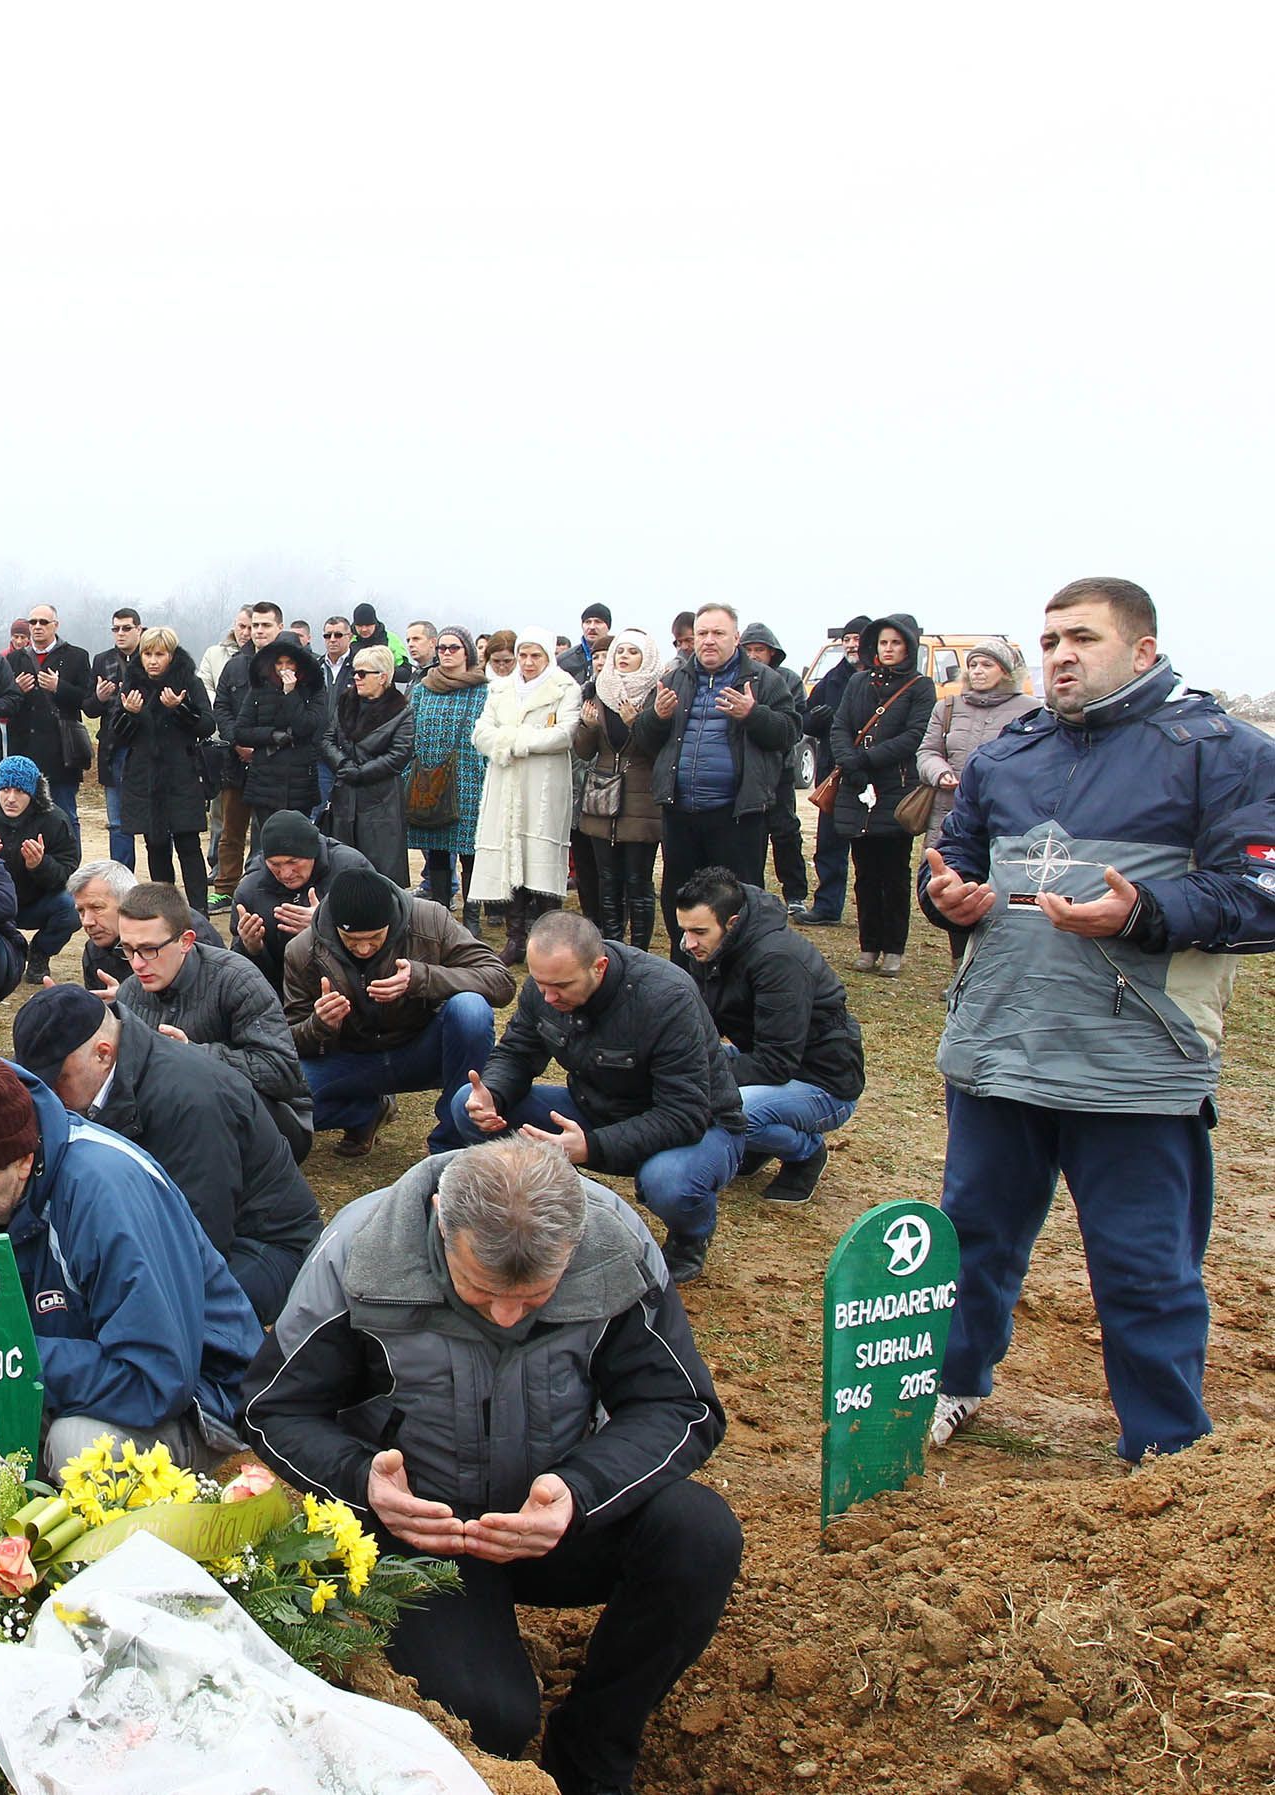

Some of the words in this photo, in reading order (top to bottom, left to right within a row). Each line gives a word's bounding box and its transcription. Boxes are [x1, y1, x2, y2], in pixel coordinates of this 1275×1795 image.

[855, 1332, 933, 1369] SUBHIJA
[834, 1383, 873, 1414] 1946
[898, 1369, 937, 1400] 2015
